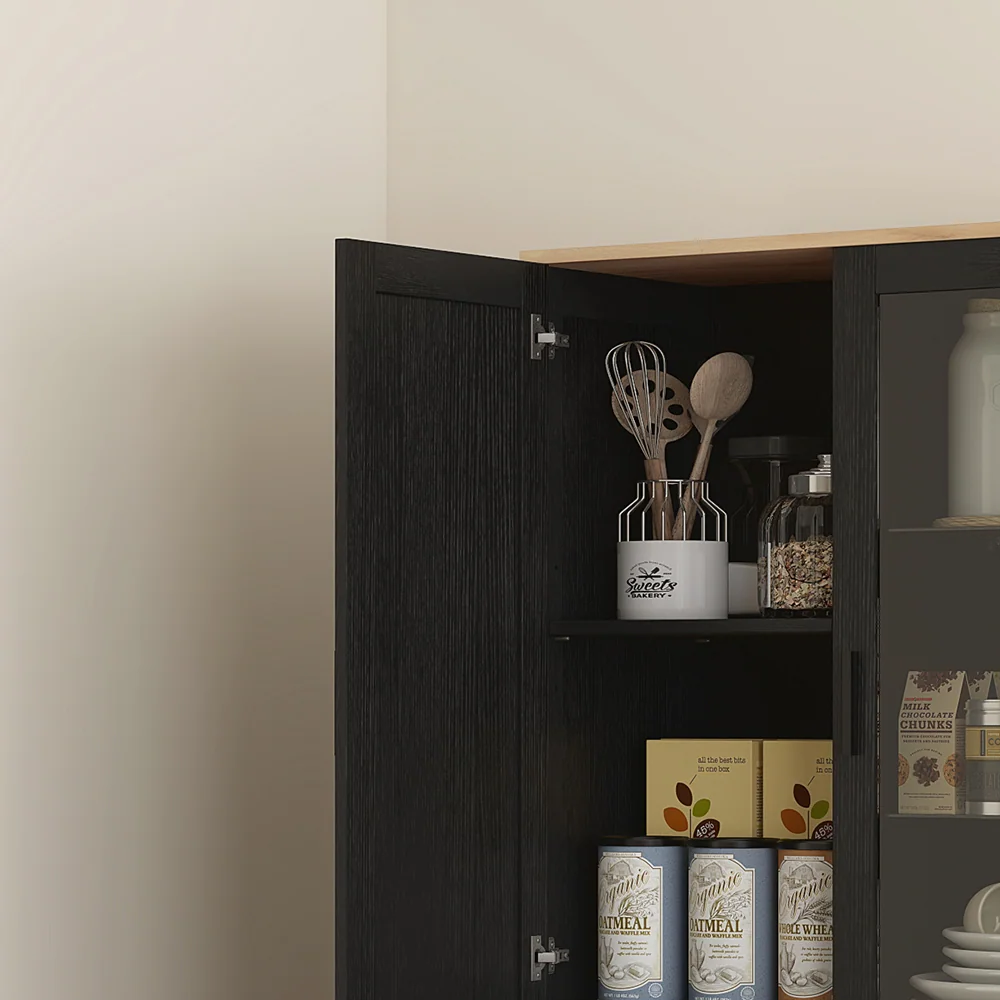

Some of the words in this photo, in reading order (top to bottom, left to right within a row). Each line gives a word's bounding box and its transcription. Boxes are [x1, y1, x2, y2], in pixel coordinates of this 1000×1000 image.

[625, 577, 678, 595] Sweets
[902, 703, 931, 711] MILK
[900, 720, 953, 730] CHUNKS
[698, 765, 705, 773] in
[718, 765, 730, 773] box
[689, 918, 743, 932] OATMEAL
[802, 924, 833, 935] WHEA
